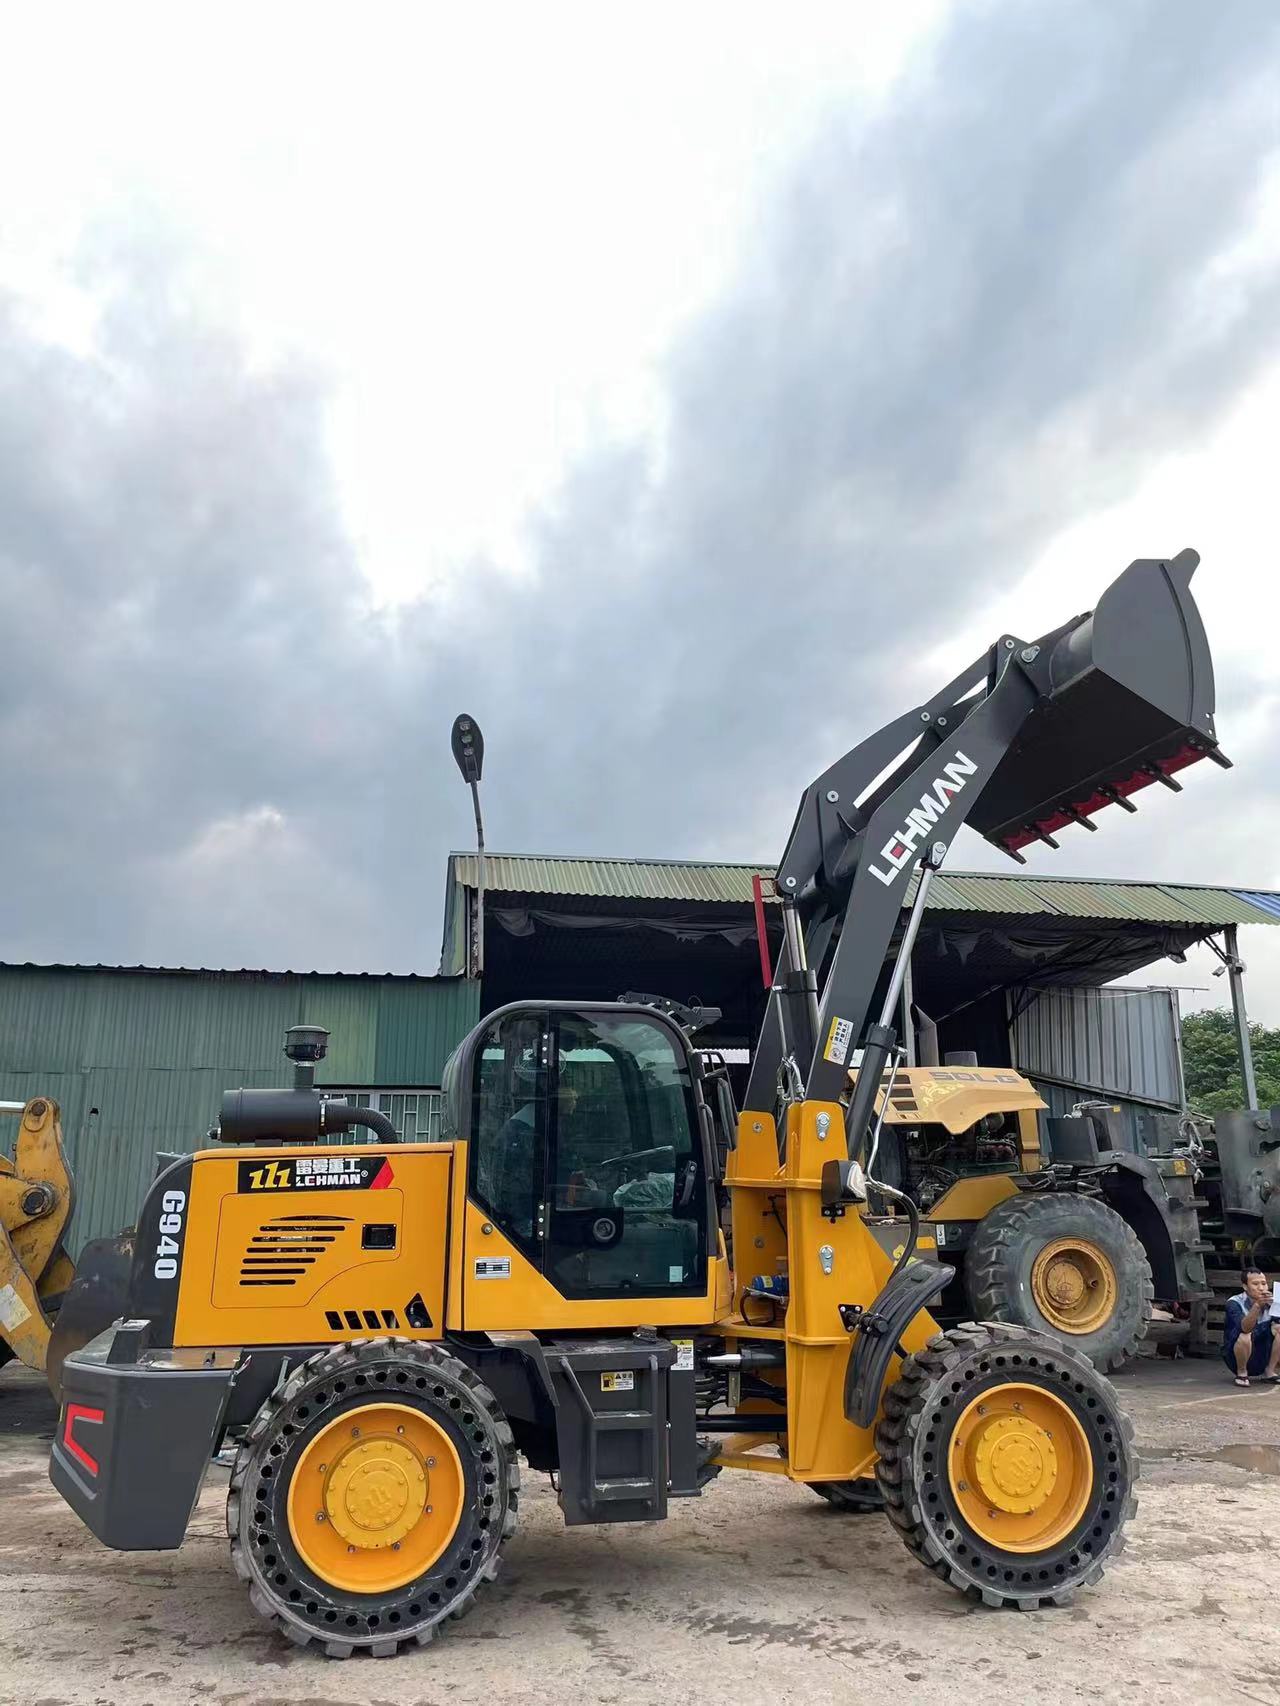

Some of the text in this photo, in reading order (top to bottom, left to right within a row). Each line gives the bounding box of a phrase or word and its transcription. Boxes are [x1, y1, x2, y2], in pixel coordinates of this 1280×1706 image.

[868, 750, 978, 887] LEHMAN
[928, 1071, 1019, 1084] SDLG
[295, 1174, 361, 1187] LEHMAN
[154, 1190, 186, 1279] G940
